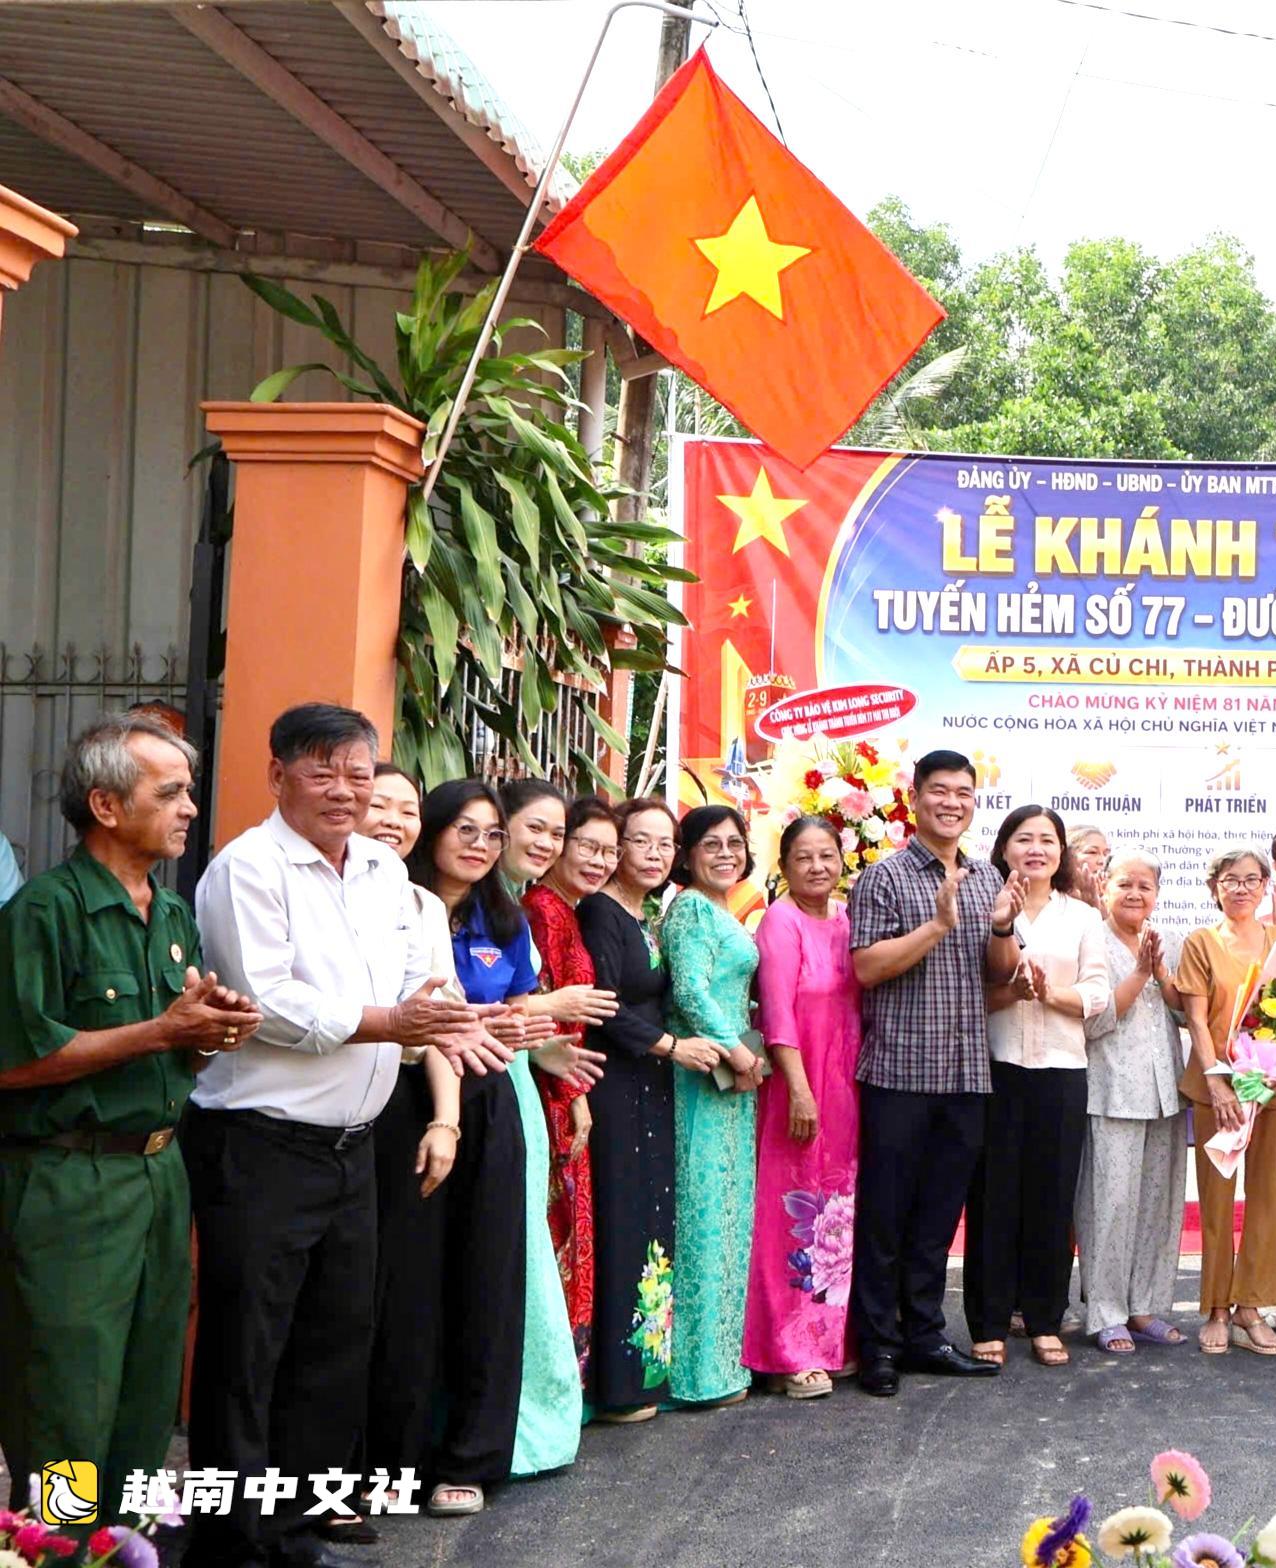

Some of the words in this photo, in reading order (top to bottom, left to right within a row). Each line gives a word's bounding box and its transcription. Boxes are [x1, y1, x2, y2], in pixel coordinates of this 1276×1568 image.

[957, 466, 1004, 489] ĐẢNG
[1008, 466, 1031, 489] ỦY
[1051, 472, 1098, 490] HĐND
[1117, 474, 1162, 492] UBND
[1181, 470, 1203, 493] ỦY
[1207, 476, 1241, 494] BAN
[942, 495, 1015, 573] LỄ
[1034, 506, 1257, 577] KHÁNH
[873, 580, 986, 633] TUYẾN
[997, 581, 1075, 634] HẺM
[1085, 583, 1136, 636] SỐ
[1141, 597, 1186, 636] 77
[984, 651, 1015, 673] ẤP
[1023, 657, 1042, 677] 5,
[1051, 654, 1081, 675] XÃ
[1089, 653, 1120, 676] CỦ
[1128, 658, 1174, 680] CHI,
[1184, 656, 1260, 677] THÀNH
[748, 690, 767, 708] 2-9
[769, 708, 793, 725] CÔNG
[793, 707, 804, 720] TY
[804, 701, 822, 717] BẢO
[822, 699, 832, 716] VỆ
[832, 699, 848, 712] KIM
[848, 695, 870, 709] LONG
[870, 688, 904, 706] SECURITY
[1028, 691, 1079, 709] CHÀO
[1085, 692, 1139, 710] MỪNG
[1145, 692, 1168, 710] KỶ
[1174, 695, 1217, 714] NIỆM
[1223, 697, 1241, 711] 81
[942, 714, 988, 729] NƯỚC
[993, 715, 1039, 732] CỘNG
[1044, 716, 1077, 730] HÒA
[1083, 716, 1104, 730] XÃ
[1109, 717, 1136, 734] HỘI
[1141, 717, 1173, 732] CHỦ
[1179, 719, 1228, 733] NGHĨA
[1234, 720, 1267, 736] VIỆT
[986, 790, 1012, 809] KẾT
[1051, 791, 1090, 811] ĐỒNG
[1095, 794, 1141, 816] THUẬN
[1185, 795, 1222, 813] PHÁT
[1226, 793, 1267, 814] TRIỂN
